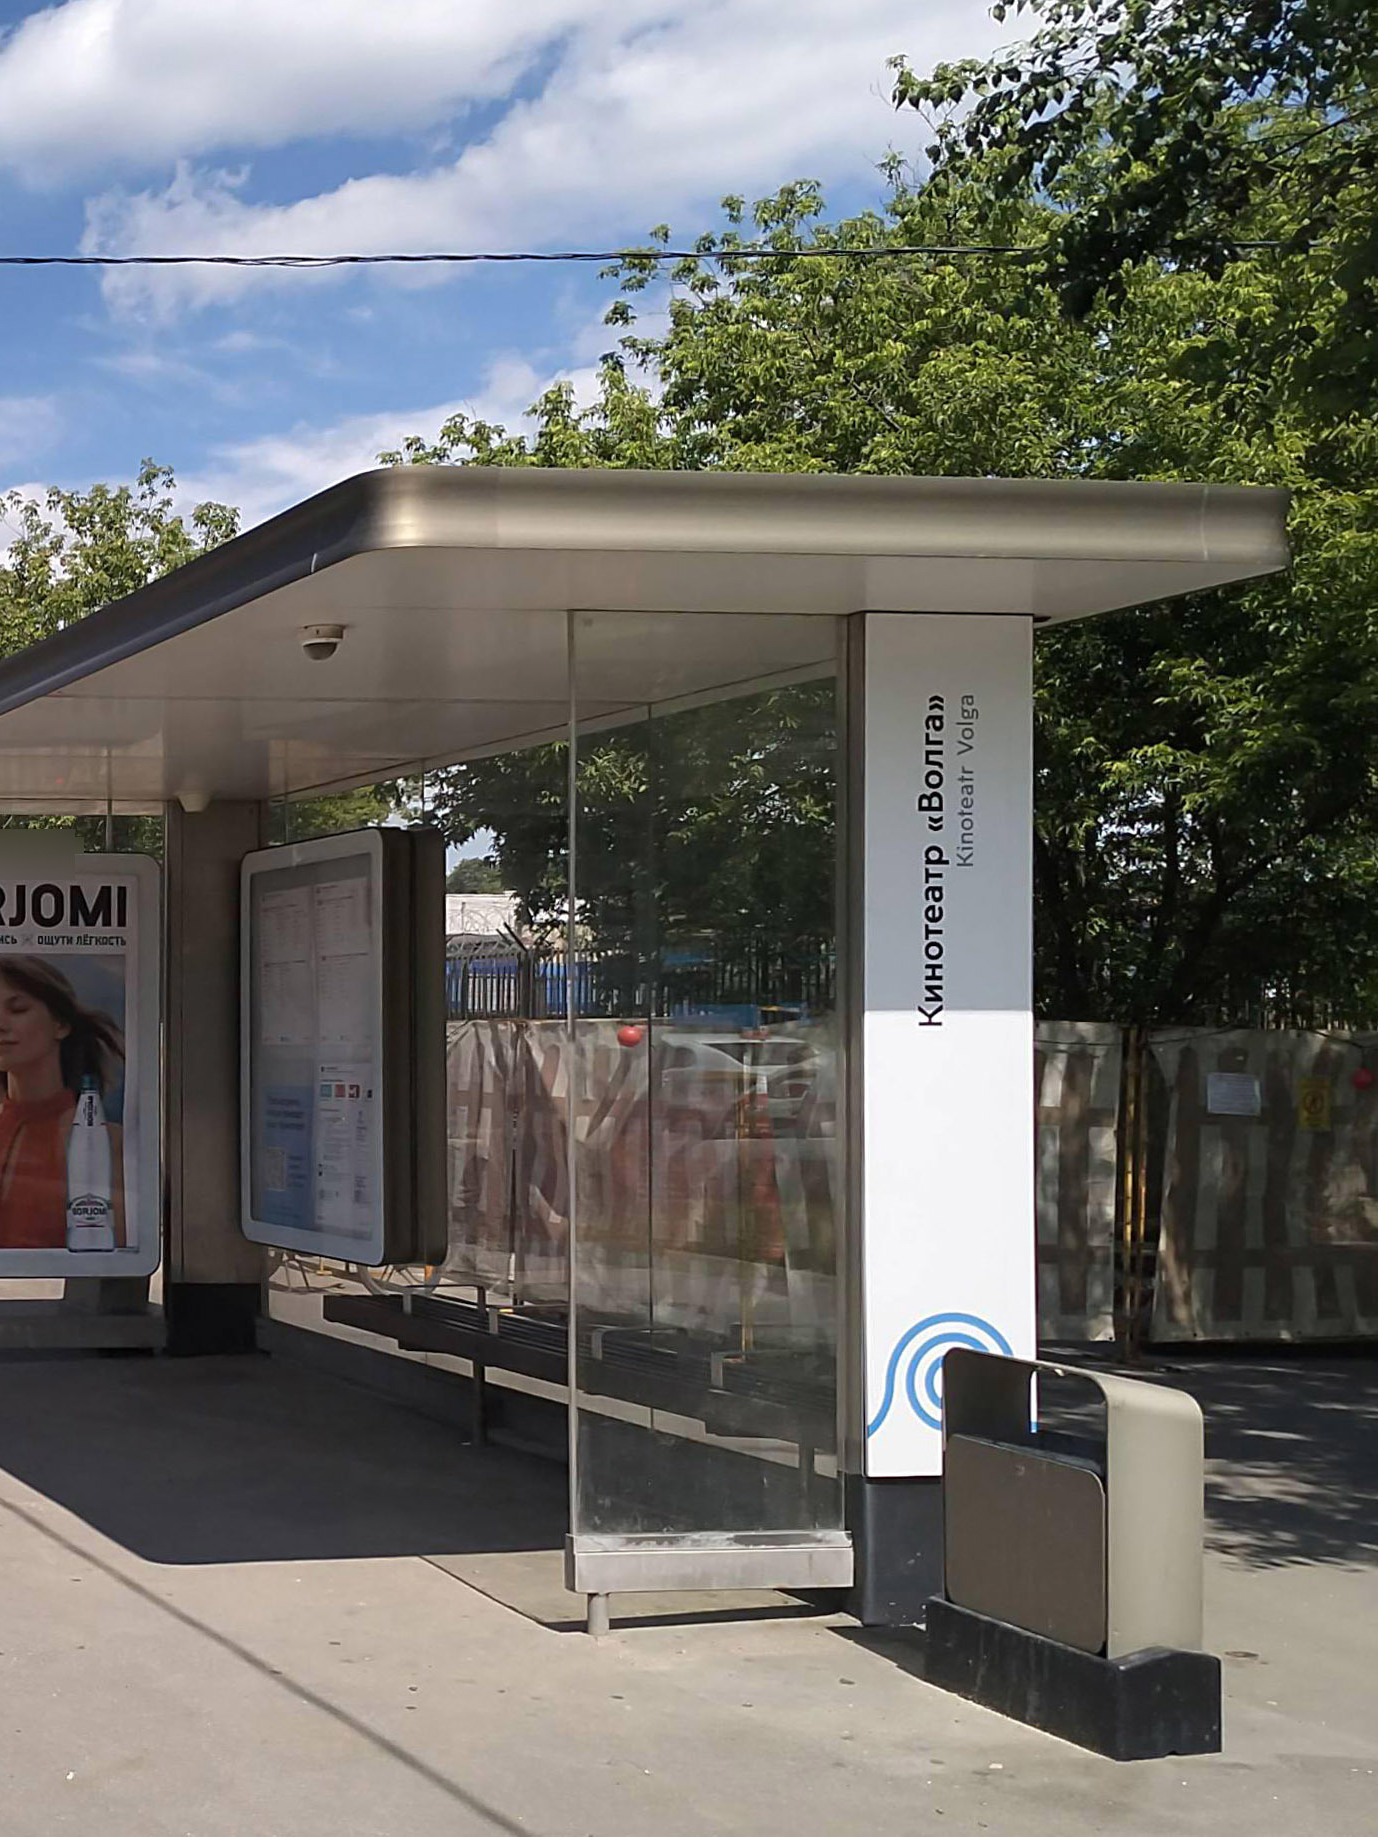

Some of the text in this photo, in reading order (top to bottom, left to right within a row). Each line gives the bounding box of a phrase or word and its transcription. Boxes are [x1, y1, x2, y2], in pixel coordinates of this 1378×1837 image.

[918, 695, 950, 1026] Кинотеатр «Волга»
[956, 694, 978, 867] Kinoteatr Volga
[37, 934, 73, 946] ОЩУТИ
[76, 932, 126, 946] ЛЁГКОСТЬ
